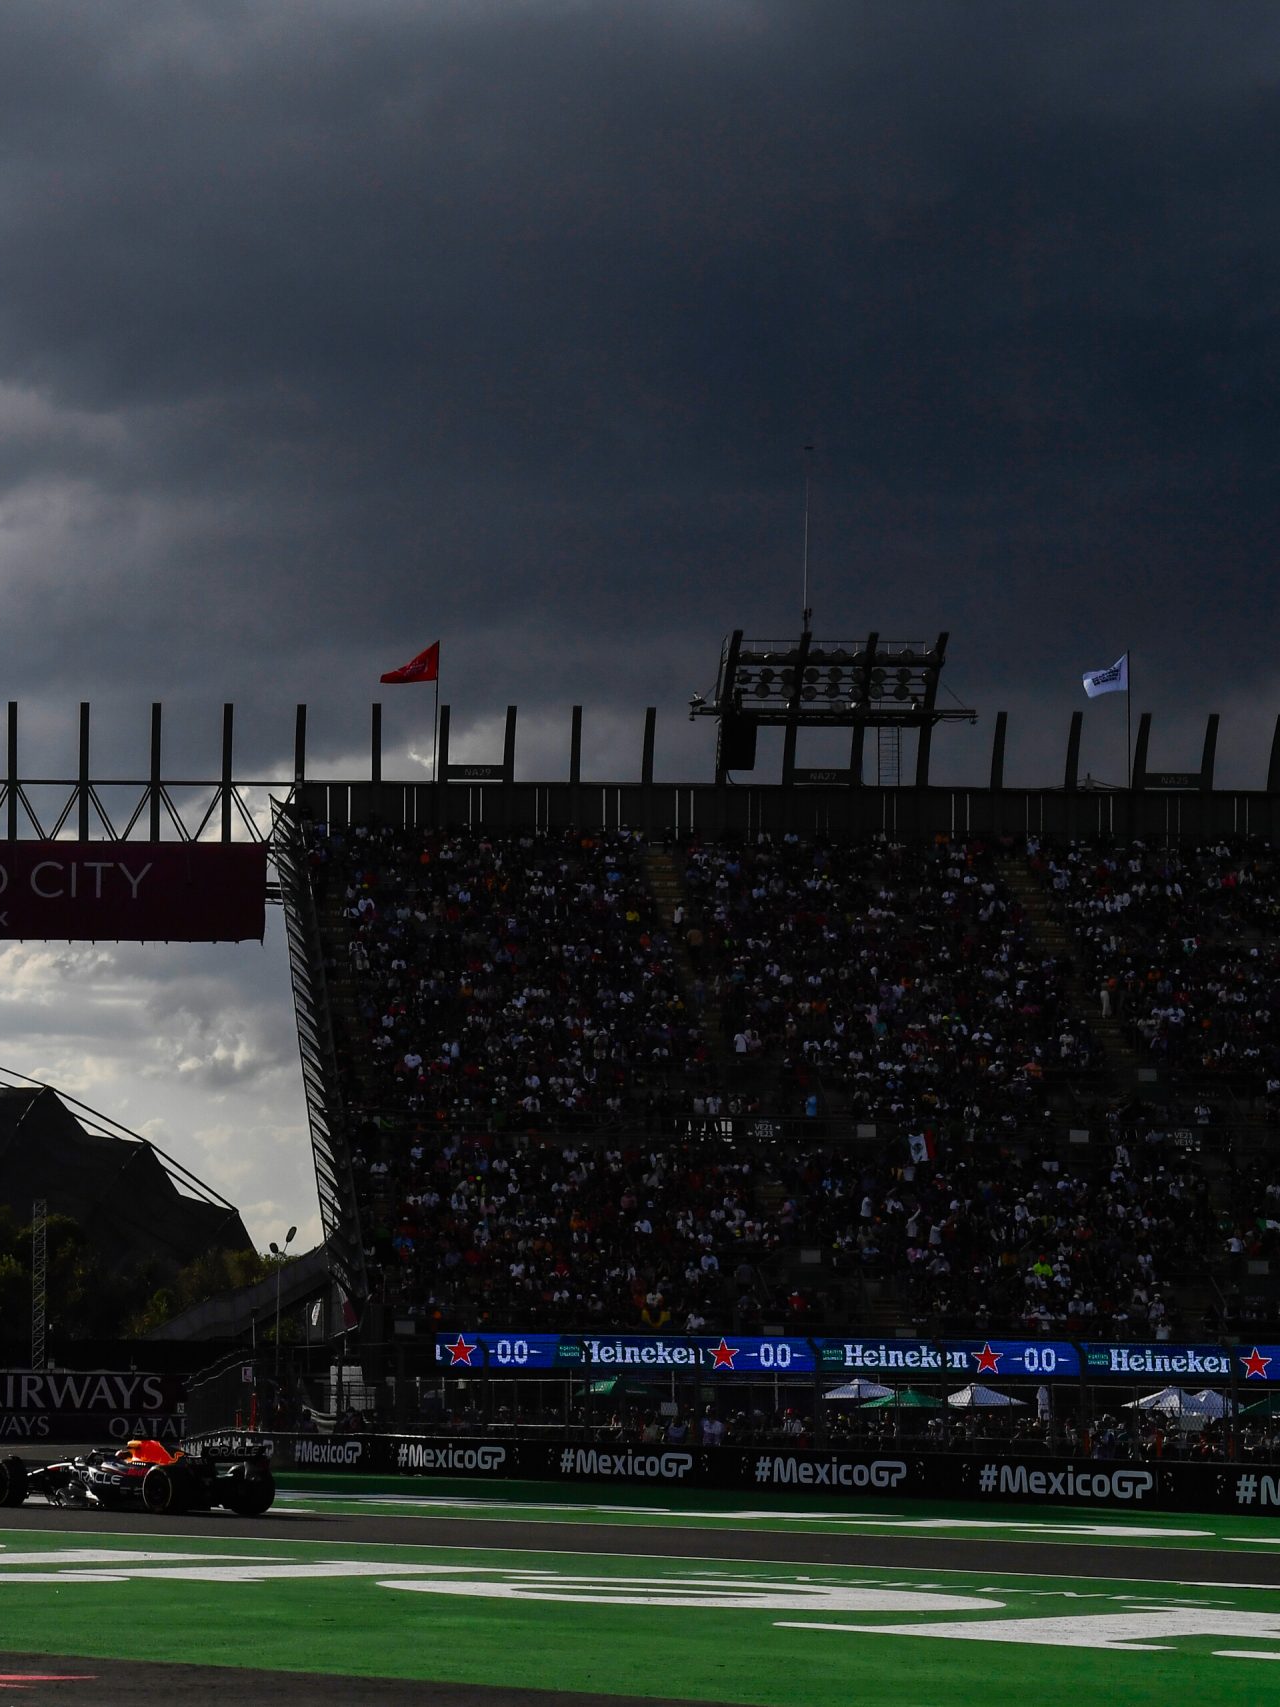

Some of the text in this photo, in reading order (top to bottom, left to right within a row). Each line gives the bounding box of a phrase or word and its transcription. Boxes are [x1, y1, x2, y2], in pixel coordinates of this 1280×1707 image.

[30, 860, 154, 899] CITY
[496, 1340, 528, 1364] 0.0
[580, 1340, 705, 1364] Heineken
[760, 1343, 791, 1368] 0.0
[843, 1344, 970, 1368] Heineken
[1024, 1347, 1056, 1372] 0.0
[209, 1446, 260, 1456] ORACLE
[294, 1440, 363, 1464] #MexicoGP
[397, 1443, 507, 1470] #MexicoGP
[559, 1445, 693, 1478] #MexicoGP
[754, 1456, 908, 1488] #MexicoGP
[978, 1464, 1154, 1499] #MexicoGP
